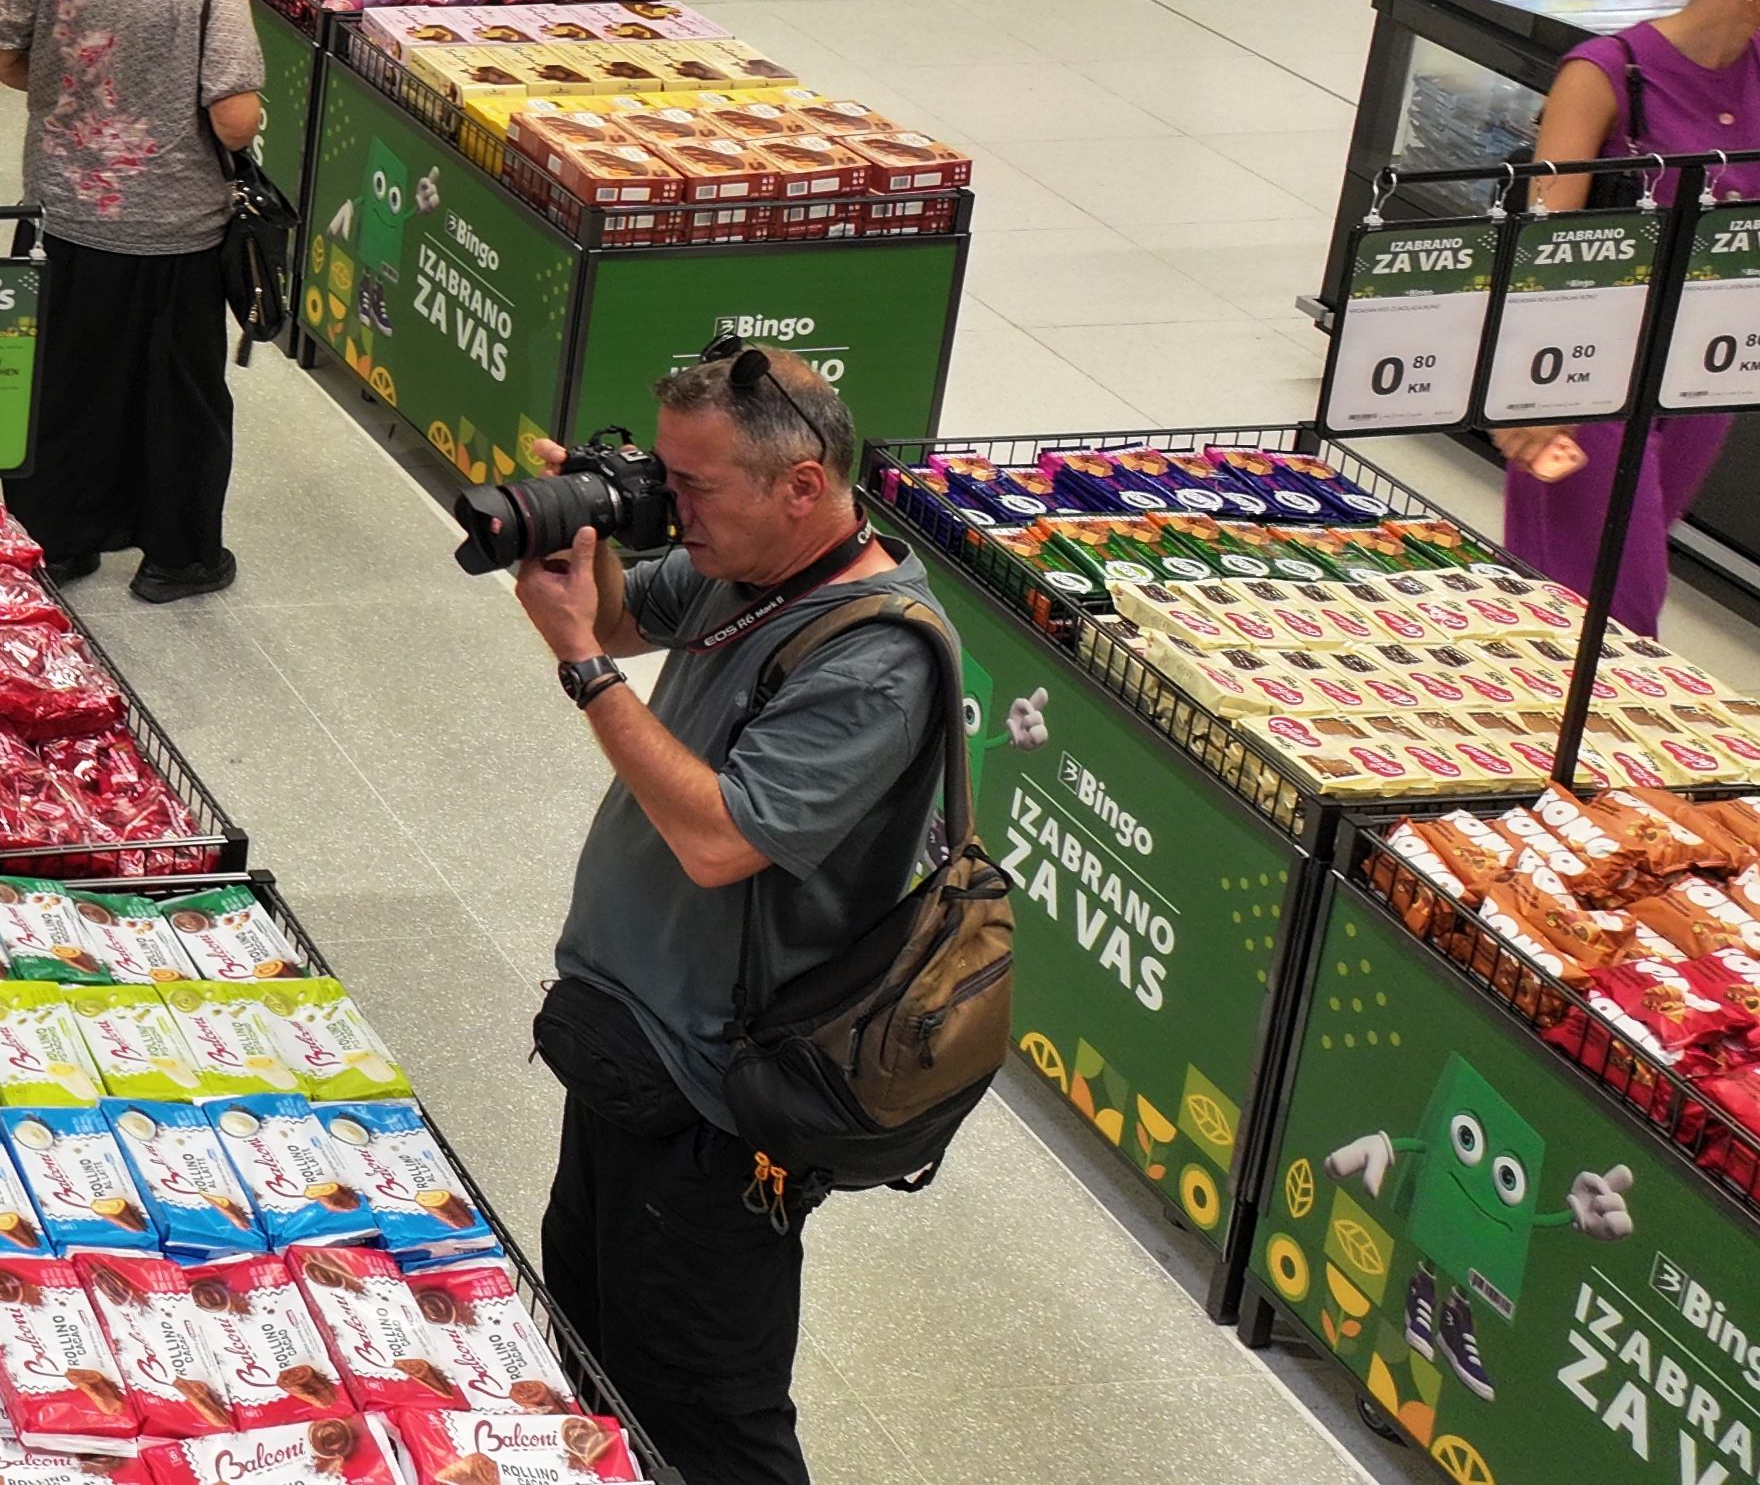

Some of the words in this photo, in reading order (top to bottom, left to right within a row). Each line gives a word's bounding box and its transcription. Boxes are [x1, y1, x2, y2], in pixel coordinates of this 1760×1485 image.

[456, 224, 499, 271] Bingo
[1391, 238, 1463, 251] IZABRANO
[1533, 244, 1580, 265] ZA
[1583, 239, 1635, 261] VAS
[1553, 228, 1624, 242] IZABRANO
[1372, 254, 1418, 275] ZA
[1421, 248, 1473, 272] VAS
[419, 244, 512, 340] IZABRANO
[412, 274, 447, 335] ZA
[456, 315, 509, 383] VAS
[736, 315, 815, 341] Bingo
[1372, 357, 1404, 395] 0
[1412, 354, 1436, 369] 80
[1530, 347, 1563, 385] 0
[1572, 345, 1595, 359] 80
[1566, 371, 1590, 384] KM
[1407, 382, 1431, 395] KM
[1077, 768, 1153, 855] Bingo
[1011, 787, 1175, 955] IZABRANO
[1000, 827, 1058, 921] ZA
[1076, 889, 1167, 1012] VAS
[1557, 1329, 1649, 1462] ZA
[1575, 1282, 1760, 1484] IZABRA
[472, 1420, 559, 1454] Balconi
